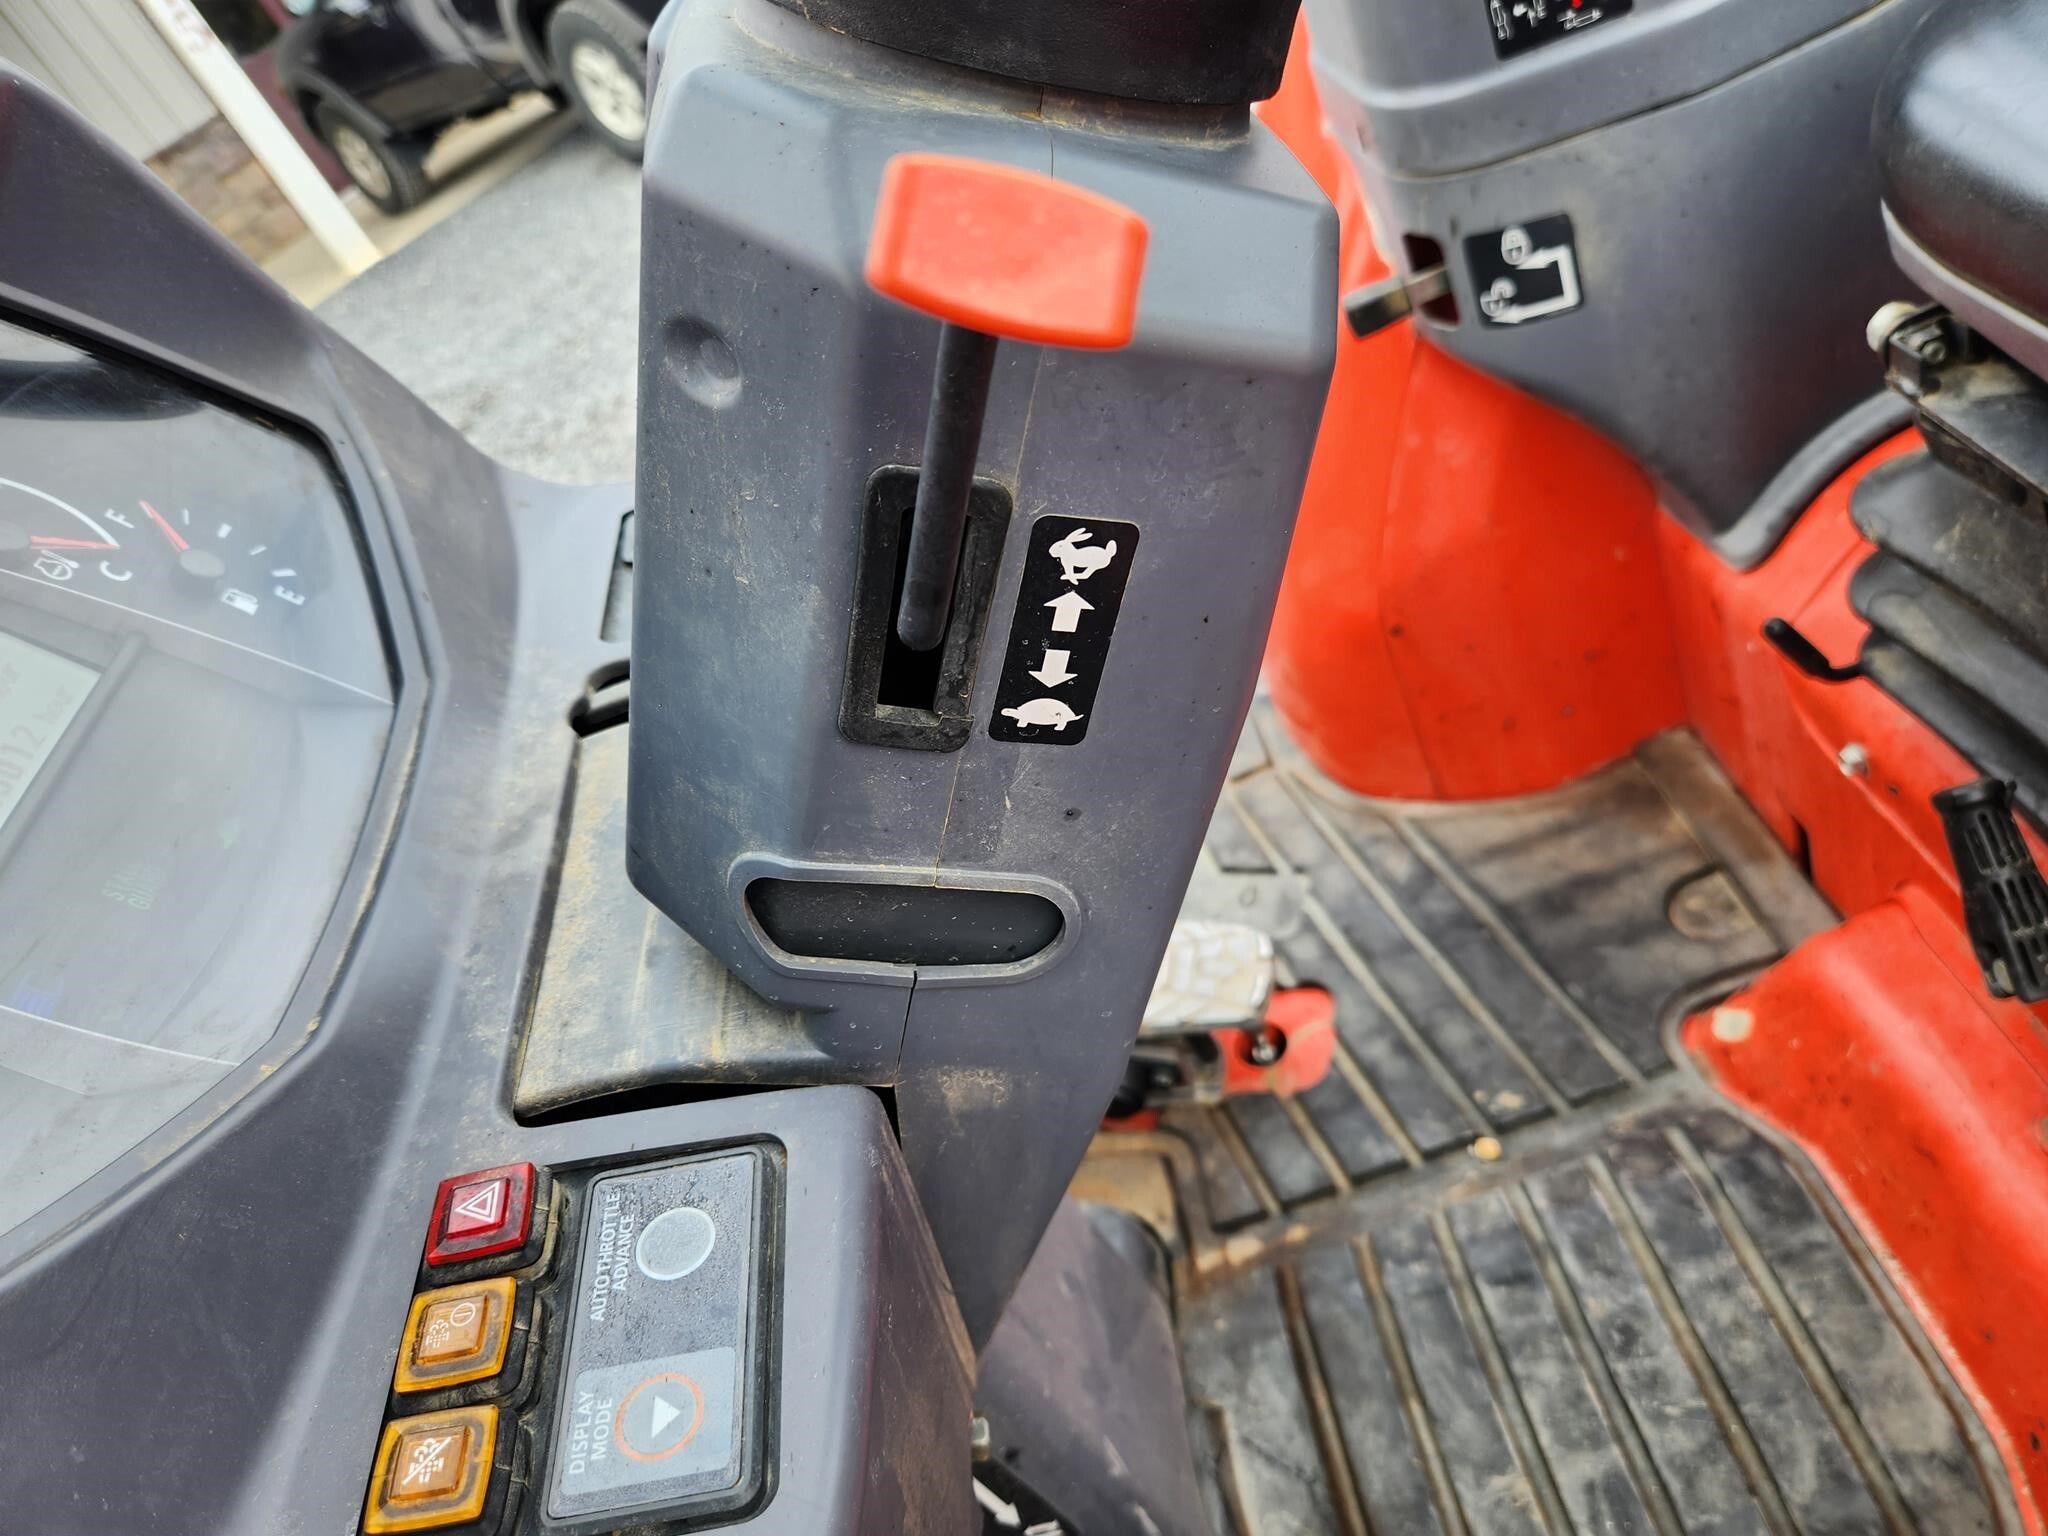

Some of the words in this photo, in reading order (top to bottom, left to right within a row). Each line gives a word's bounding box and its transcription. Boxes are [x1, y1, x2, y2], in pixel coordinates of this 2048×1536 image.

[104, 508, 136, 530] F
[99, 560, 134, 582] C
[273, 585, 306, 606] E
[590, 1192, 621, 1321] AUTOTHROTTLE
[612, 1213, 635, 1291] ADVANCE
[569, 1391, 594, 1474] DISPLAY
[590, 1398, 613, 1460] MODE
